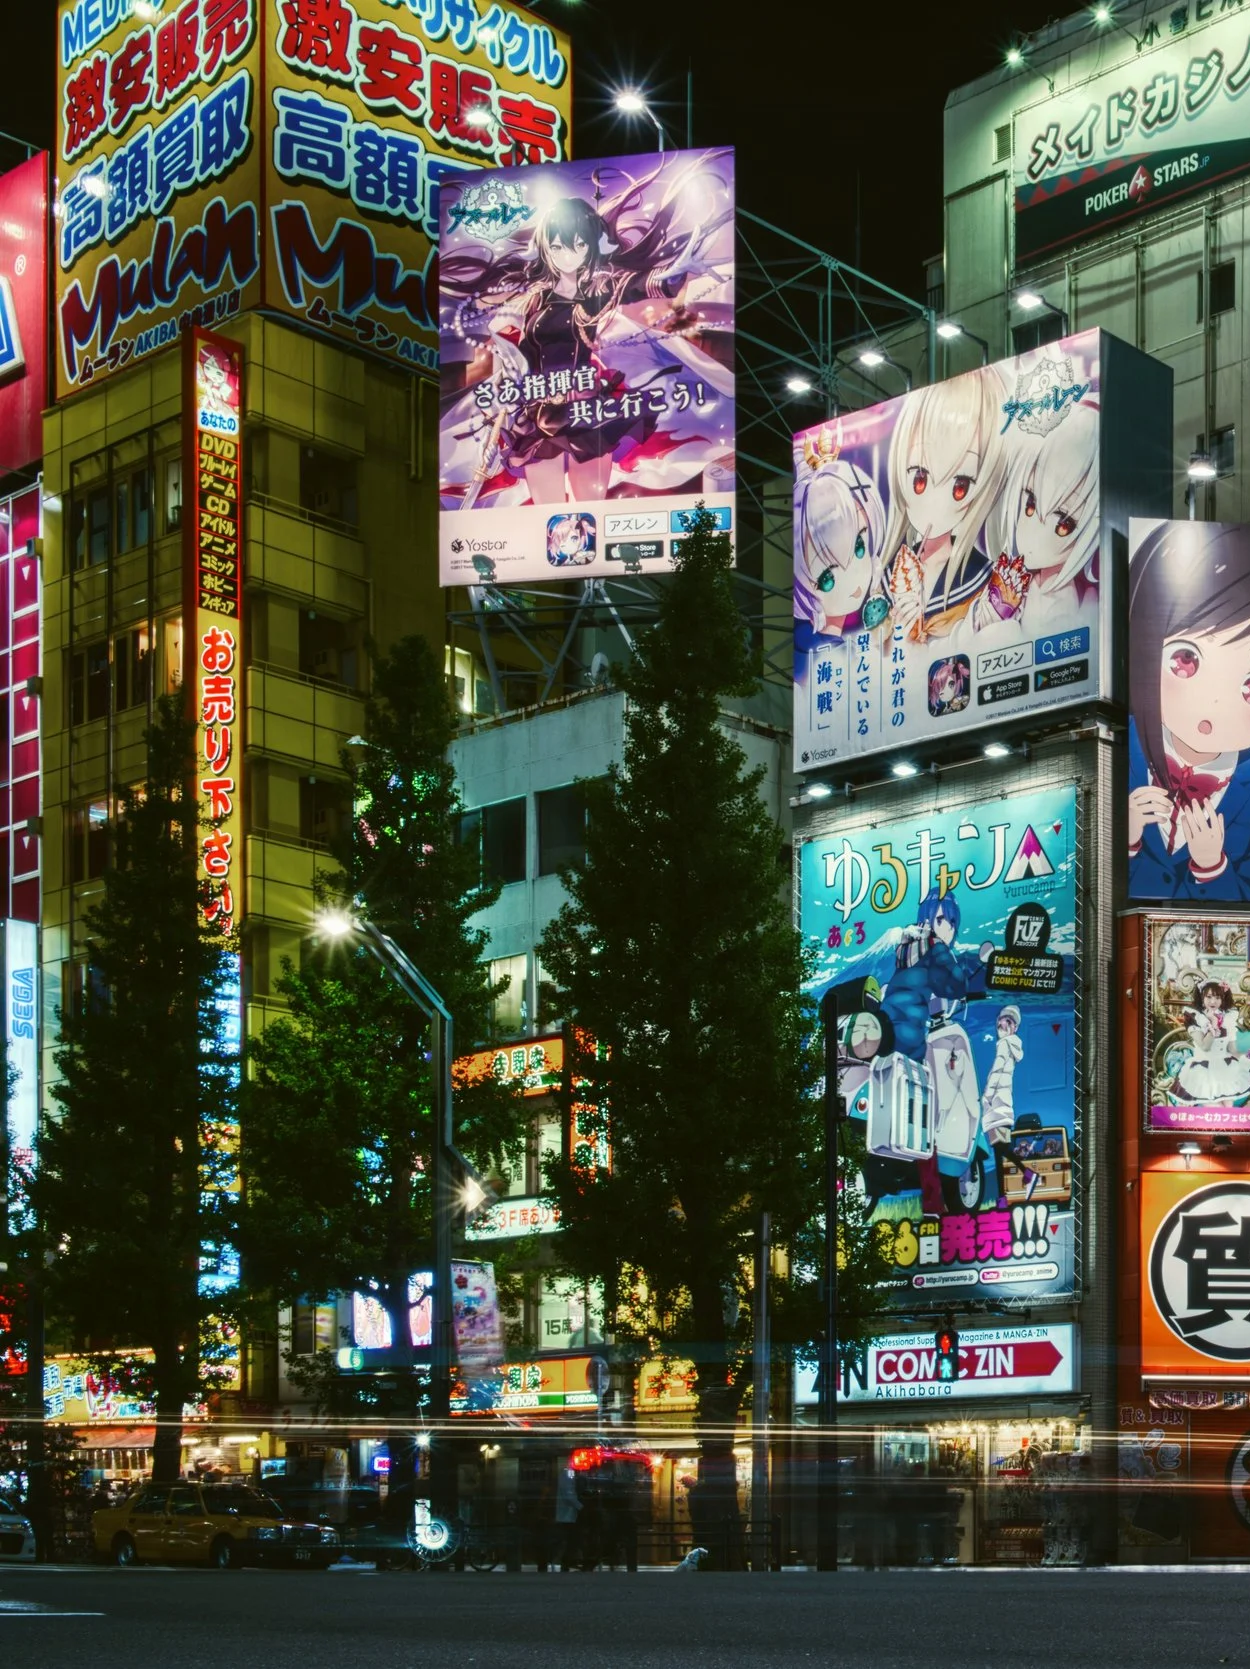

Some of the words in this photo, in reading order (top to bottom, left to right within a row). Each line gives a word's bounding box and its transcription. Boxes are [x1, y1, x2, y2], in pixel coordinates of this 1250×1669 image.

[62, 74, 251, 264] 高額買取
[1085, 182, 1129, 216] POKER
[60, 198, 260, 384] Mulan
[305, 297, 399, 350] ムーラン
[397, 335, 440, 371] AKI
[79, 337, 136, 384] ムーラン
[134, 317, 178, 357] AKIBA
[200, 410, 237, 432] あなたの
[201, 433, 236, 460] DVD
[200, 472, 237, 499] ゲーム
[205, 494, 231, 516] CD
[200, 511, 236, 538] アイドル
[608, 515, 660, 533] アズレン
[199, 531, 237, 557] アニメ
[465, 538, 508, 553] Yostar
[201, 552, 236, 577] コミック
[202, 573, 234, 595] ホビー
[1059, 635, 1082, 653] 検索
[981, 651, 1025, 674] アズレン
[1049, 668, 1069, 679] Google
[1069, 665, 1081, 674] Play
[834, 666, 844, 702] ロマン
[855, 633, 870, 738] 望んでいる
[891, 624, 906, 729] これが君の
[809, 746, 838, 761] Yostar
[1003, 879, 1057, 899] Yurucamp
[1013, 914, 1045, 946] FUZ
[11, 966, 34, 1040] SEGA
[919, 1223, 939, 1235] FRI
[873, 1337, 916, 1349] rofessional
[974, 1345, 1015, 1377] ZIN
[875, 1384, 953, 1399] Akihabara
